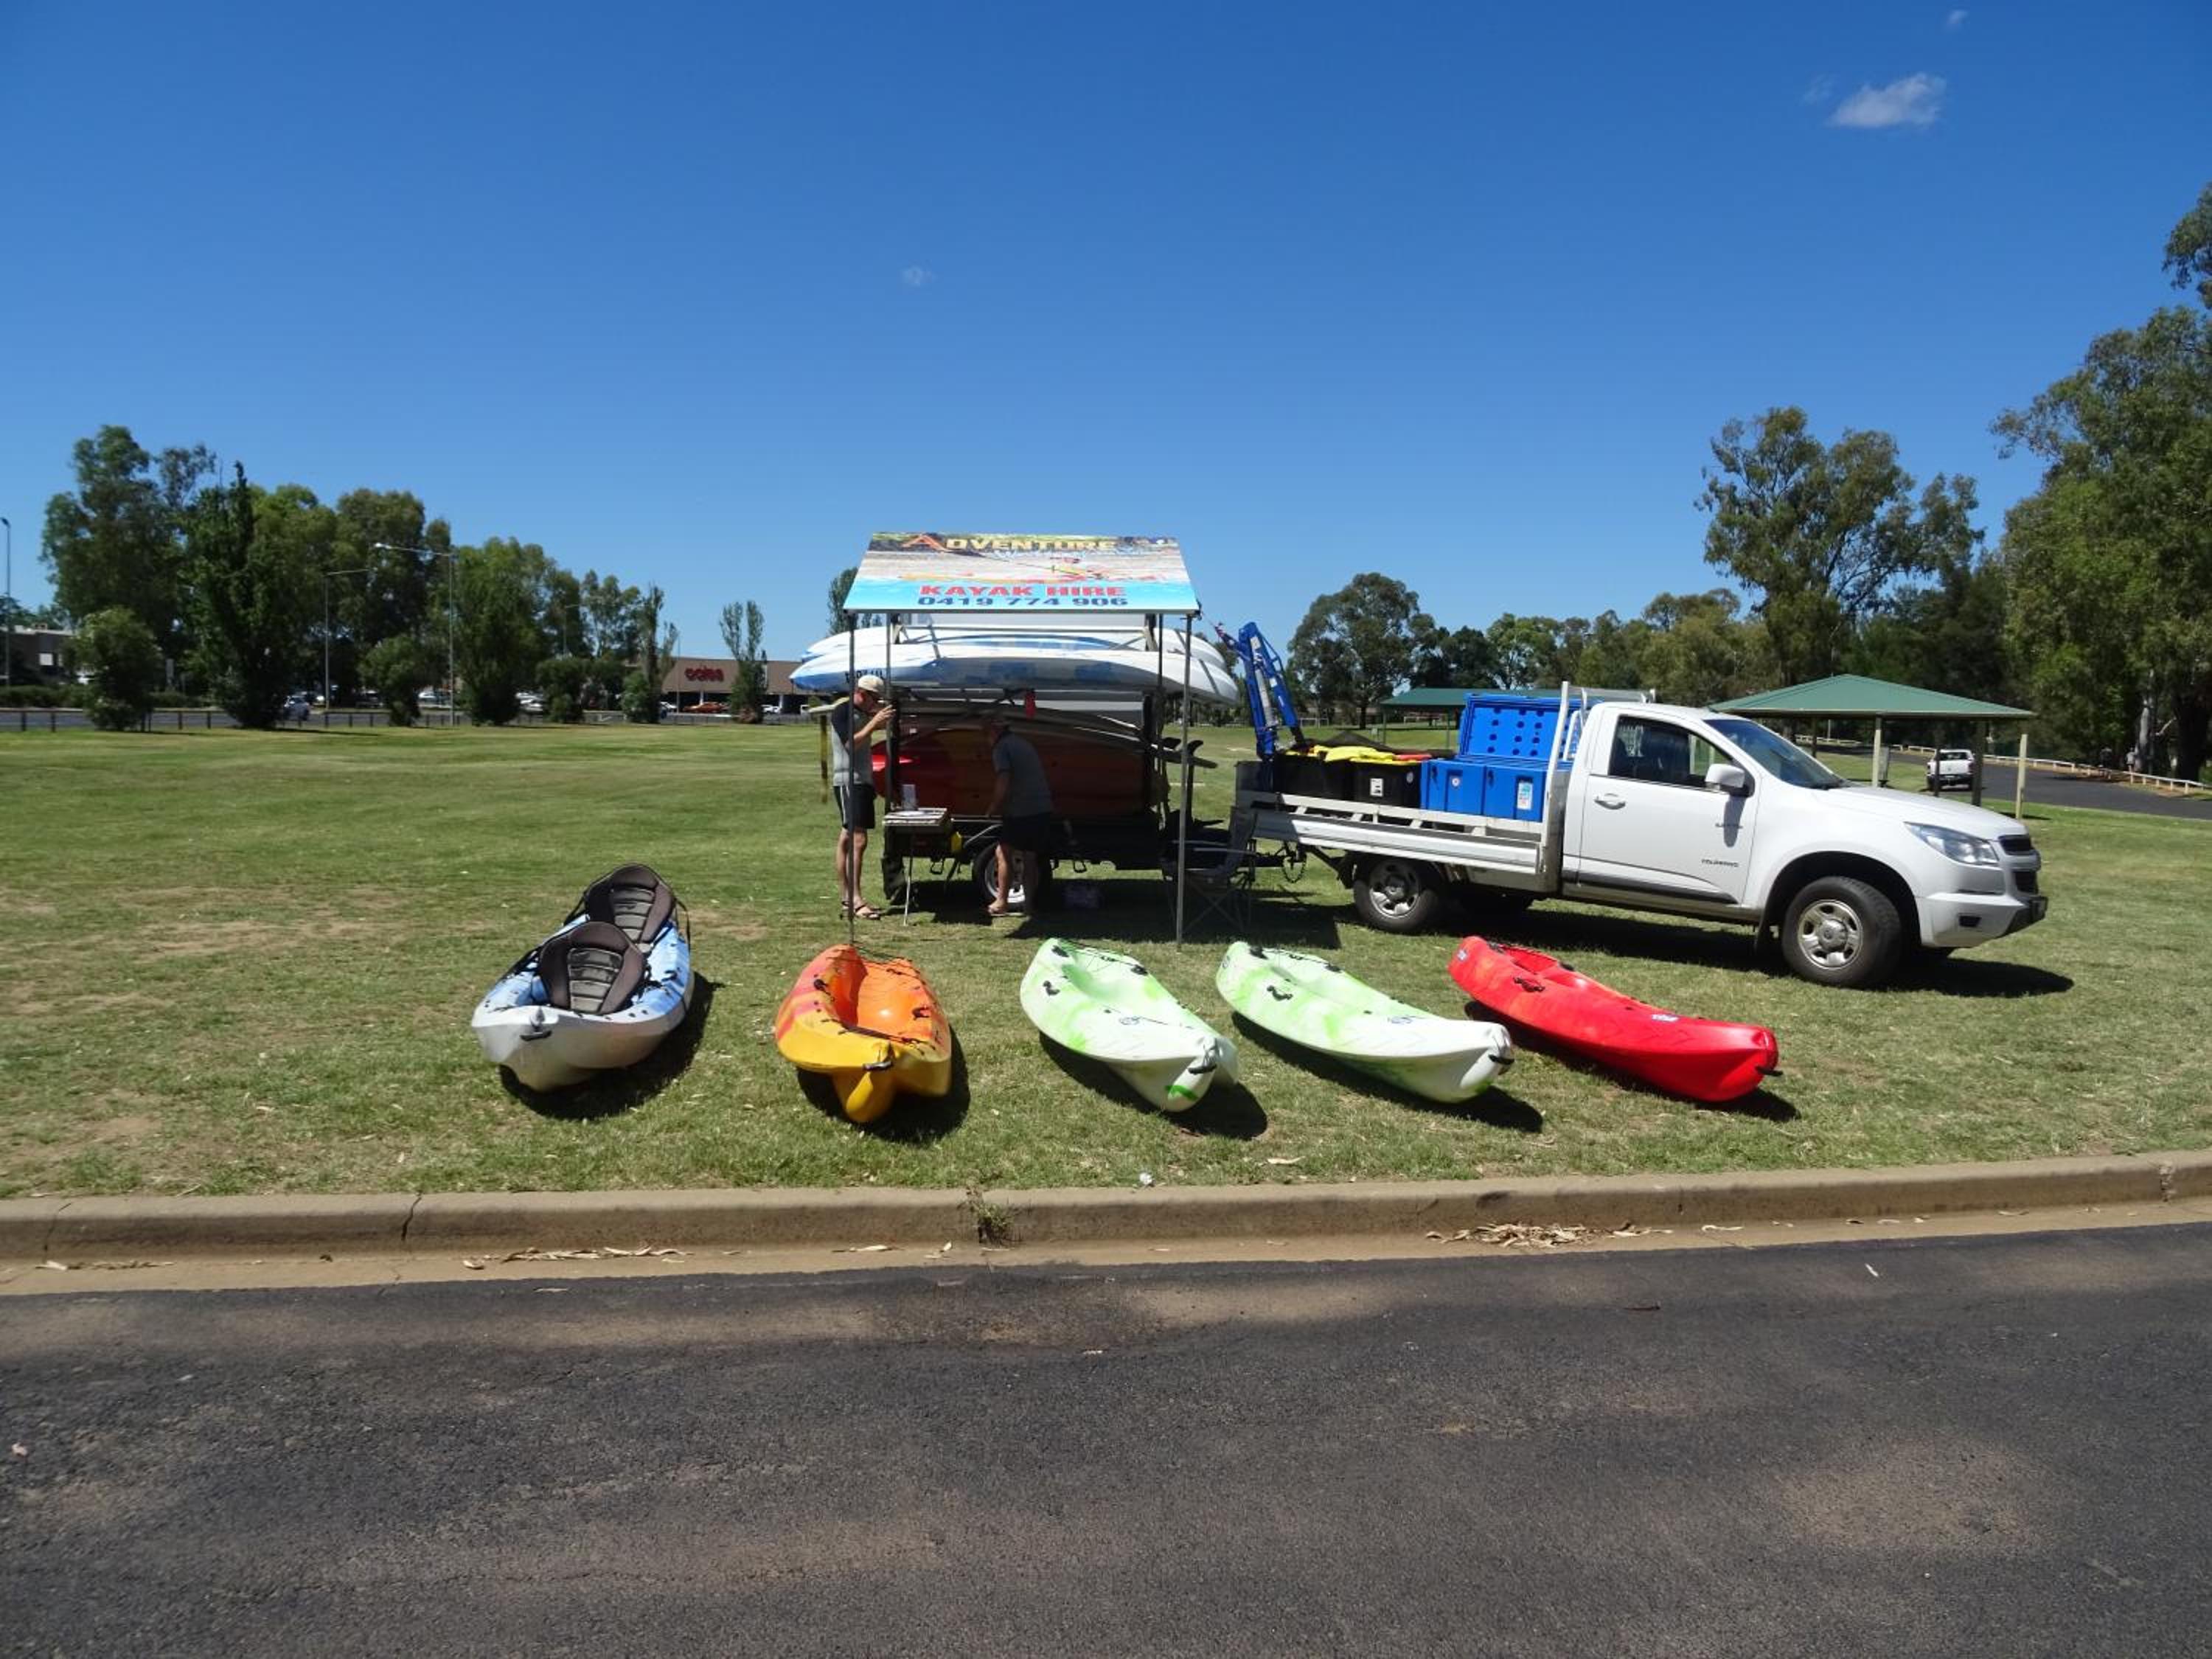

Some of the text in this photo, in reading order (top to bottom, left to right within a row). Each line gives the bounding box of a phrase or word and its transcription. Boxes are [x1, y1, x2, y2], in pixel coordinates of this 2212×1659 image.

[919, 585, 1127, 597] KAYAK HIRE
[918, 596, 1129, 606] 0419 774 906
